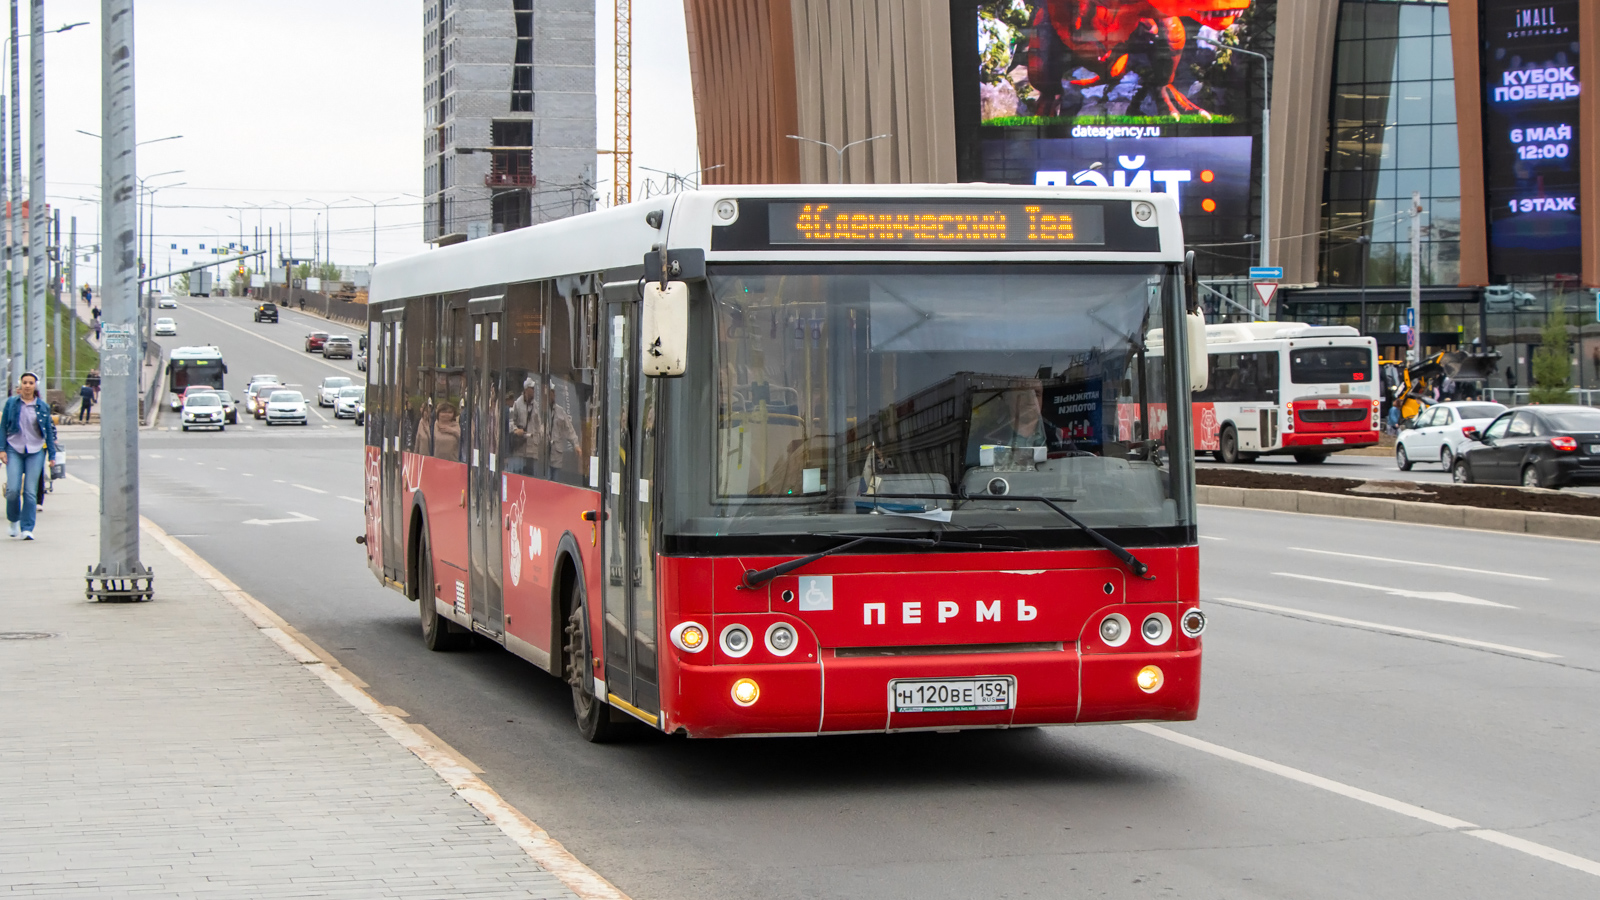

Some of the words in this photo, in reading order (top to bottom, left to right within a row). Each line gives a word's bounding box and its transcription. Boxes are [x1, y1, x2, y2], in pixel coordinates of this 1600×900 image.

[1516, 7, 1556, 28] iMALL
[1503, 66, 1575, 86] КУБОК
[1071, 125, 1160, 139] dateagency.ru
[1510, 129, 1523, 143] 6
[1526, 125, 1571, 141] МАЯ
[1517, 144, 1569, 160] 12:00
[1509, 199, 1517, 212] 1
[1520, 197, 1576, 212] ЭТАЖ
[863, 599, 1038, 625] ПЕРМЬ
[903, 685, 973, 704] Н120ВЕ
[977, 683, 1003, 697] 159
